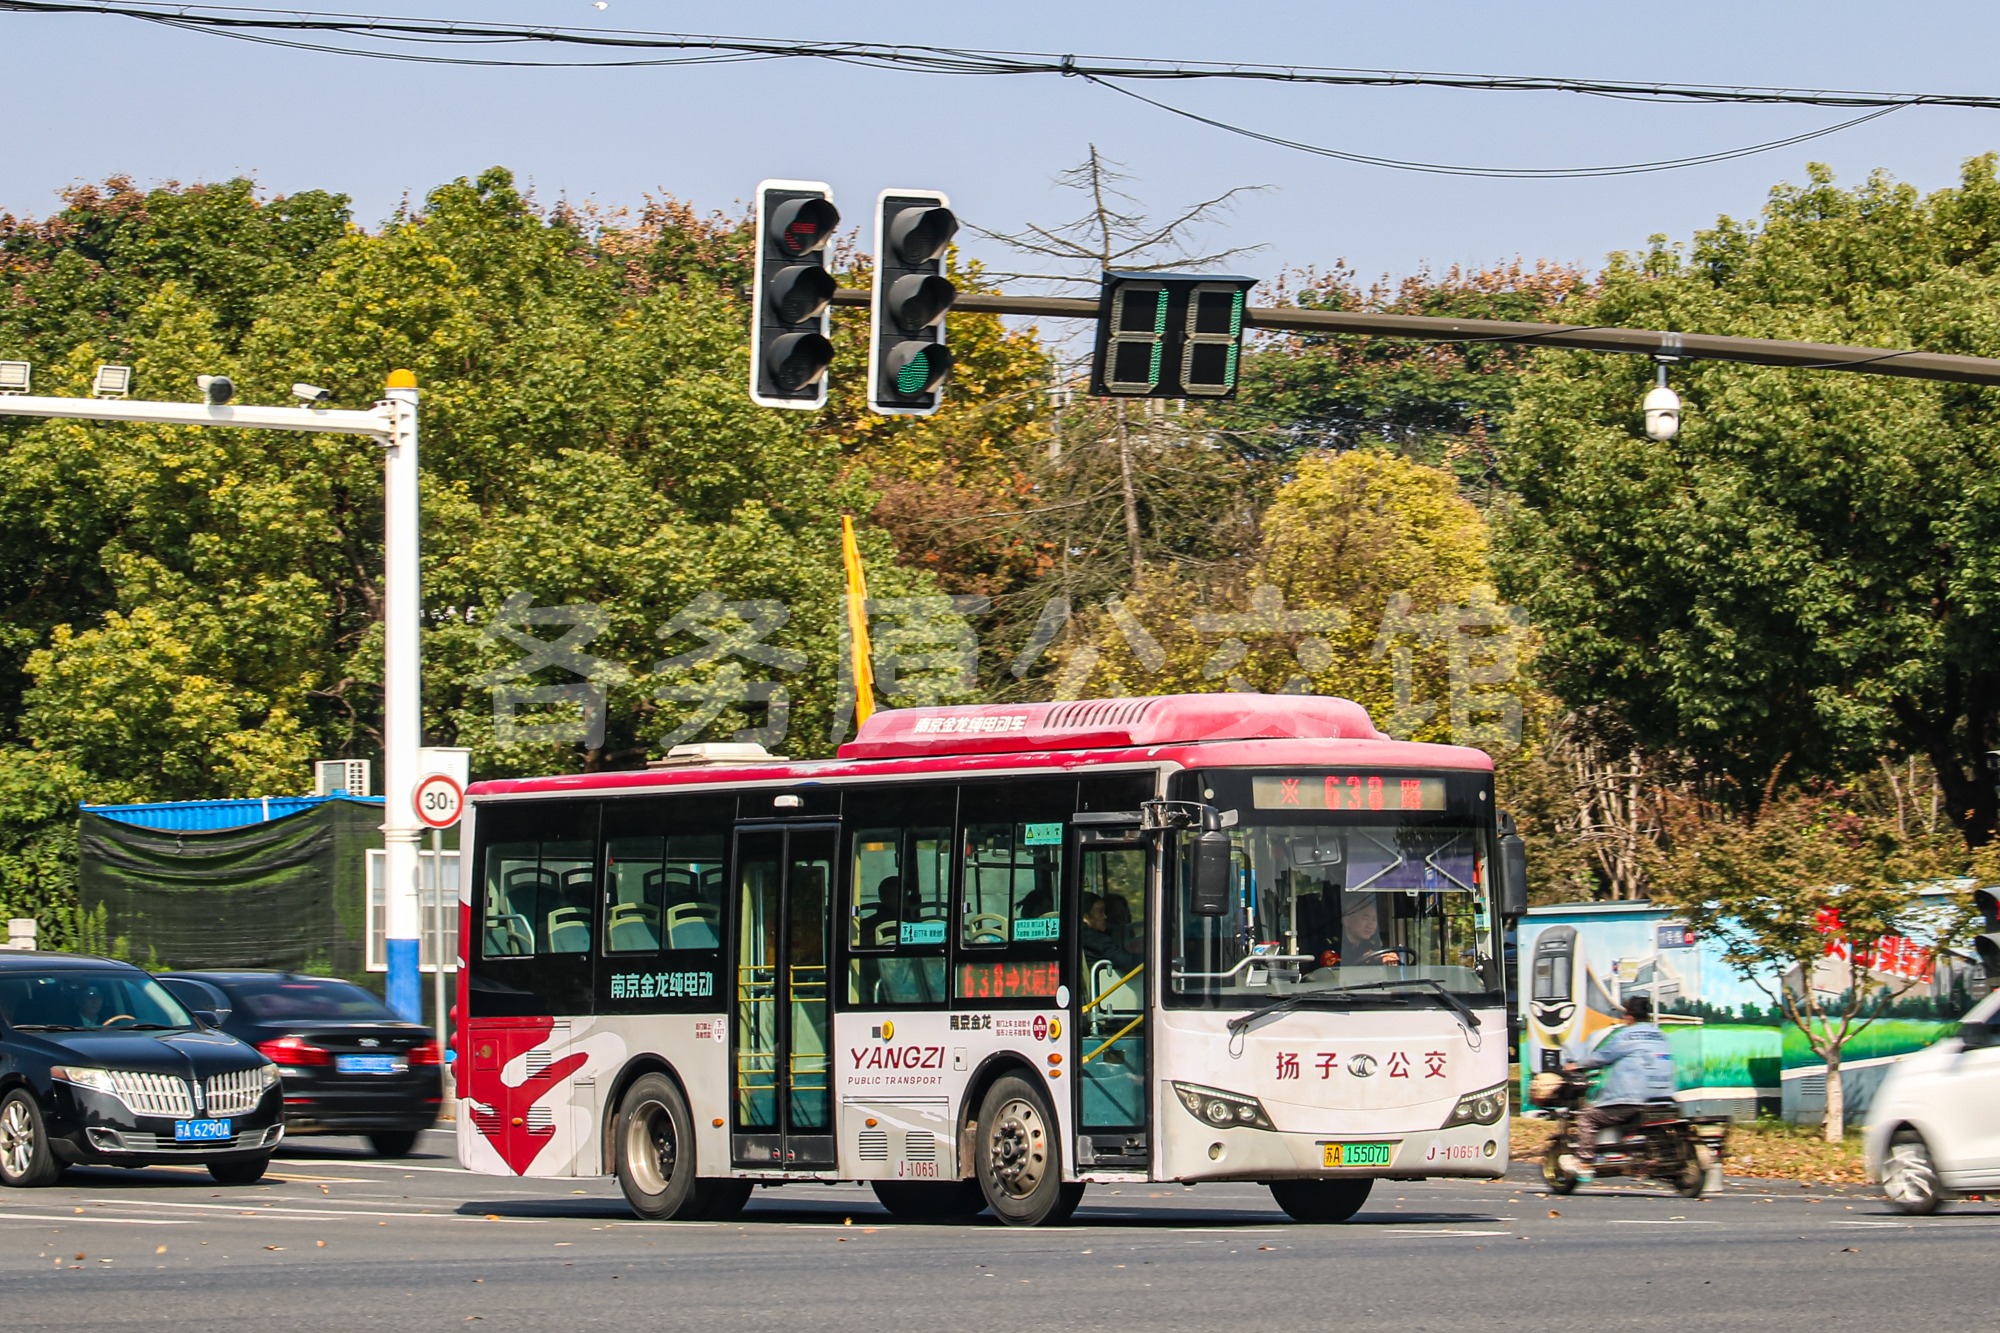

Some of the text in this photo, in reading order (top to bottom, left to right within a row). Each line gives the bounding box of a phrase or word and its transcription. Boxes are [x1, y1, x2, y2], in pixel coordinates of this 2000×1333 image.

[913, 715, 1028, 733] 南京金龙纯电动车
[1324, 775, 1385, 811] 638
[610, 971, 713, 999] 南京金龙纯电动
[963, 963, 1004, 998] 638
[717, 1020, 722, 1028] 下
[949, 1014, 992, 1031] 南京金龙
[850, 1045, 946, 1070] YANGZI
[1276, 1050, 1447, 1080] 扬子 公交
[847, 1076, 943, 1085] PUBLIC TRANSPORT
[1346, 1146, 1390, 1163] 15507D
[898, 1160, 940, 1178] J-10651
